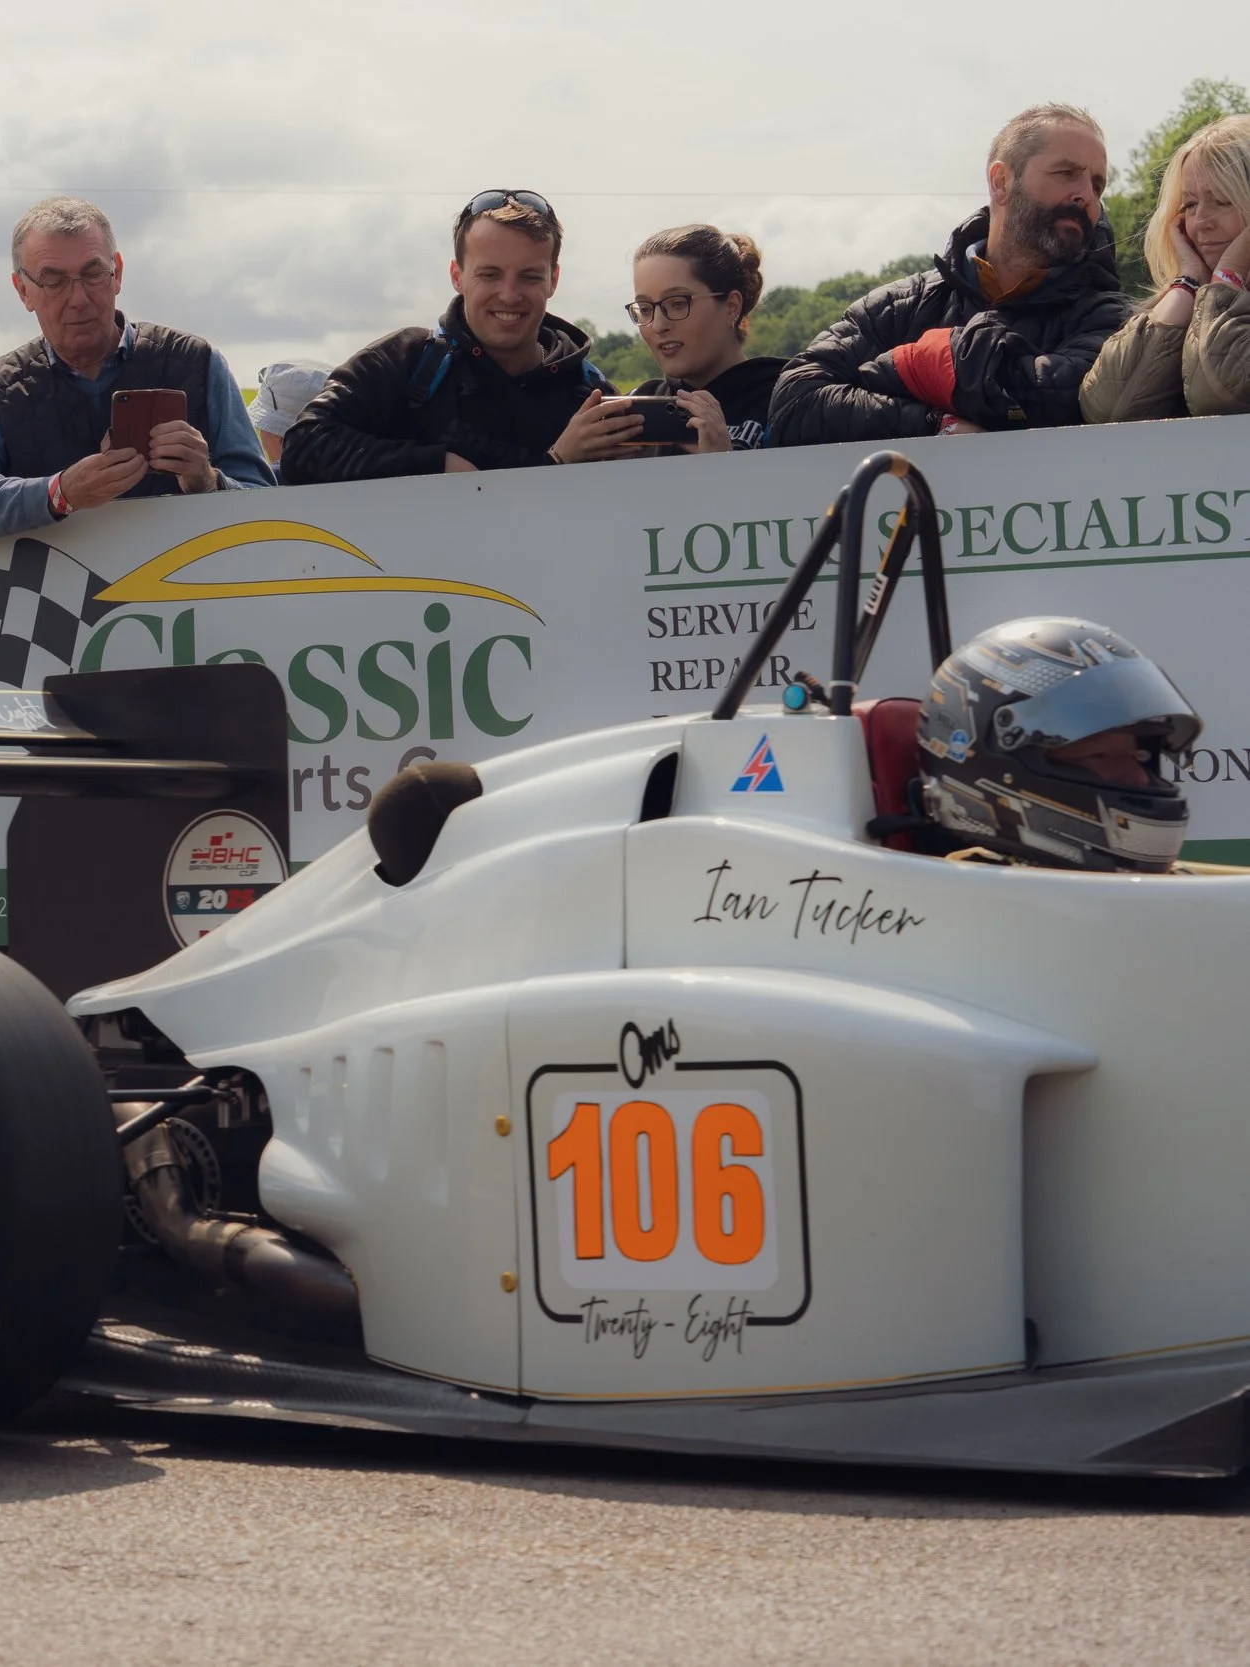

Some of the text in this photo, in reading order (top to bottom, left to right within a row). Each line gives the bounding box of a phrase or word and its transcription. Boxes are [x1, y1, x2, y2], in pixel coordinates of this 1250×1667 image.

[643, 516, 841, 577] LOTU
[78, 602, 534, 745] ssic
[211, 846, 262, 864] BHC
[693, 859, 926, 945] Ian Tucker
[547, 1100, 765, 1266] 106
[580, 1295, 658, 1359] Twenty
[684, 1294, 754, 1362] Eight
